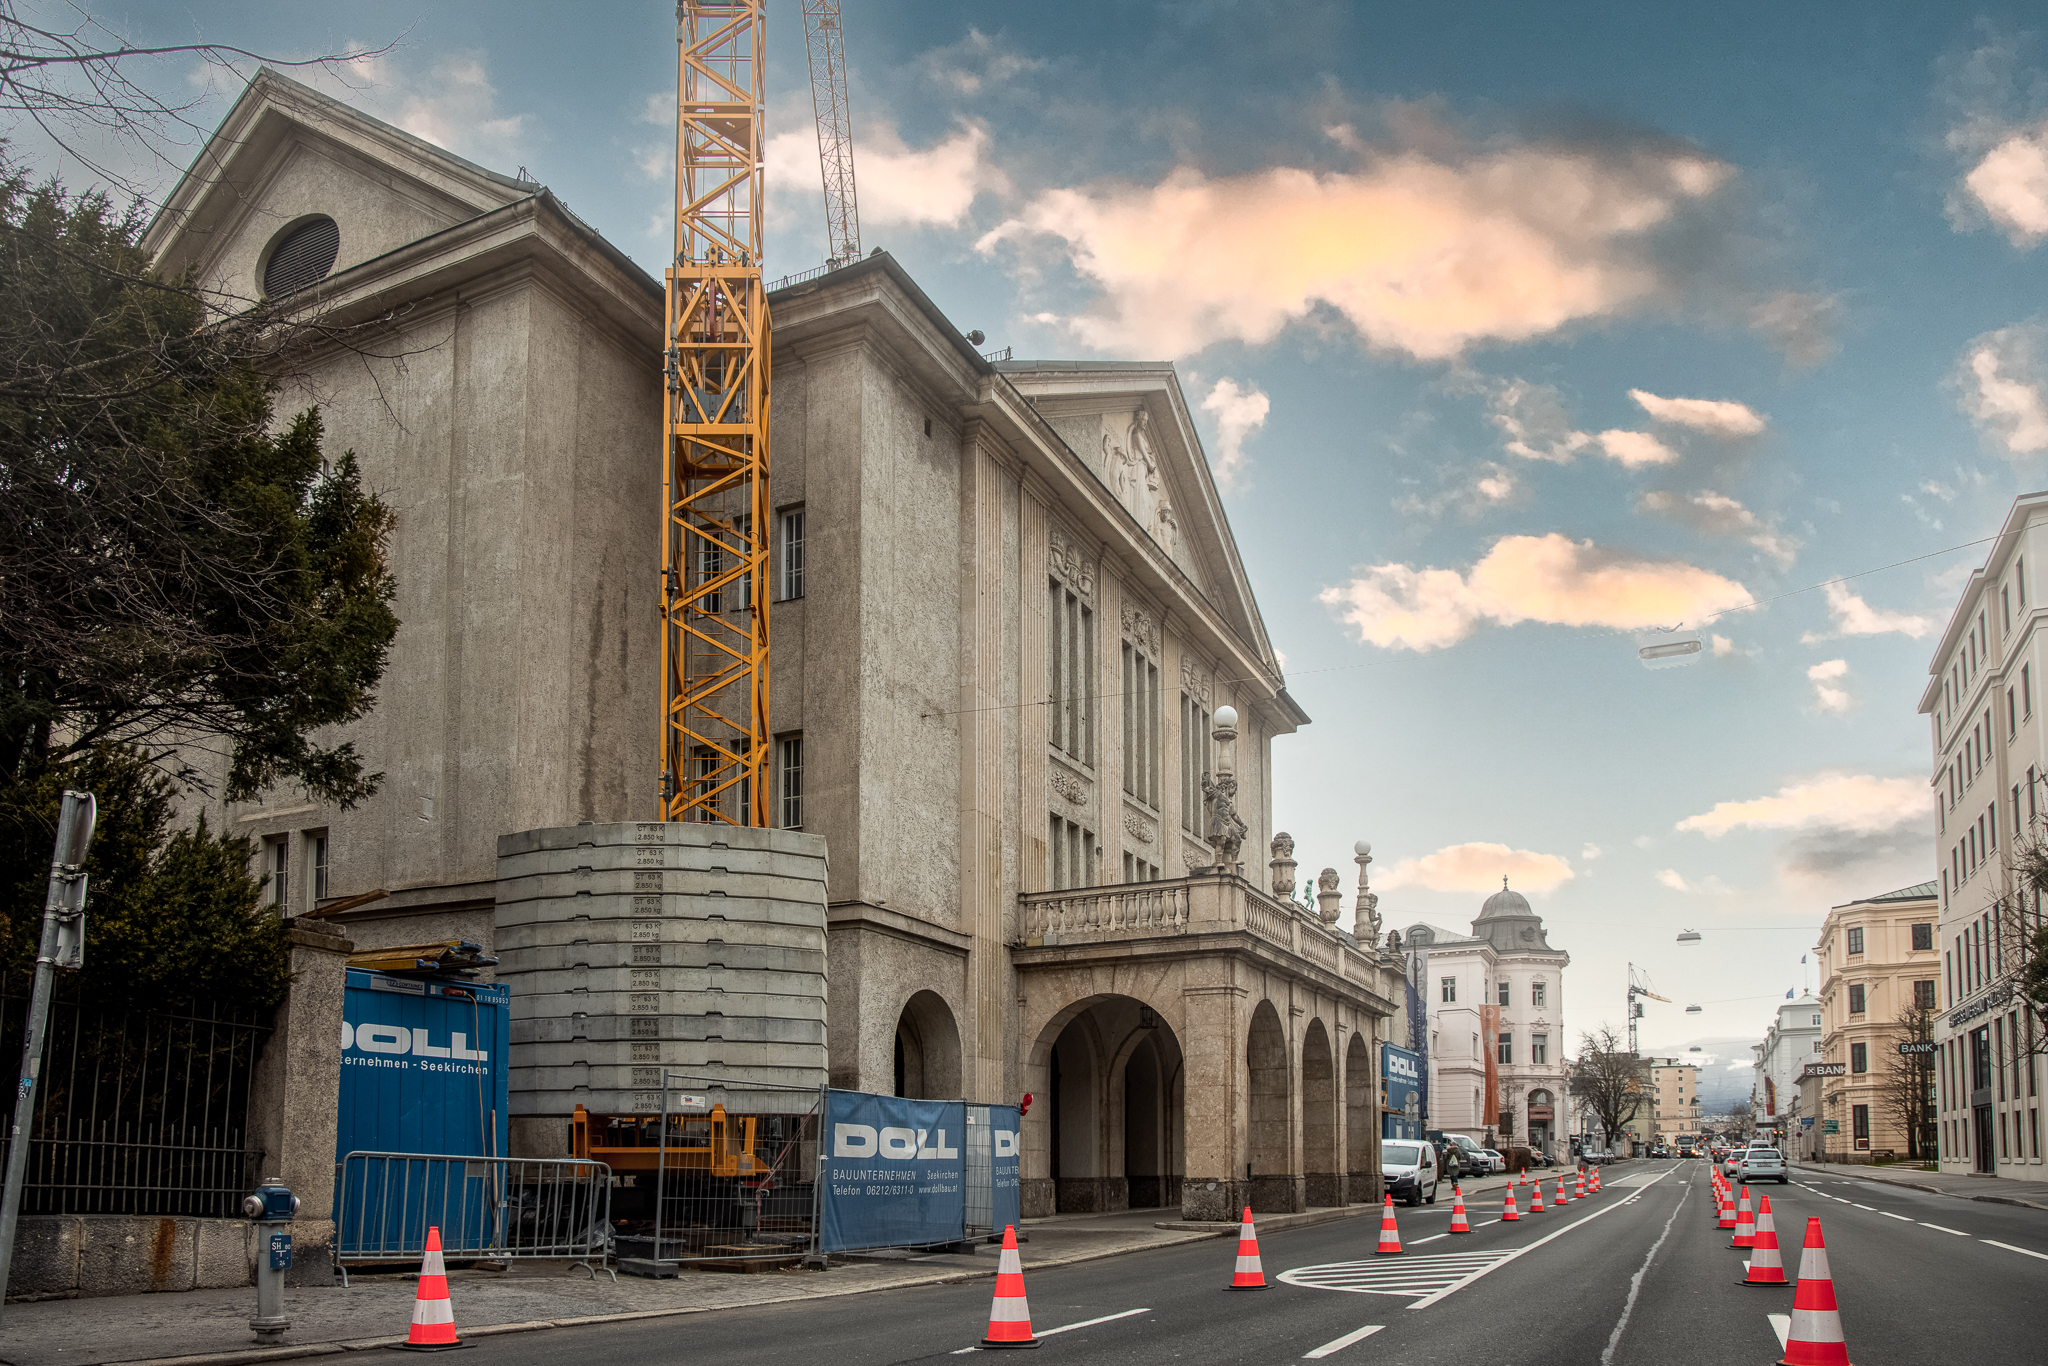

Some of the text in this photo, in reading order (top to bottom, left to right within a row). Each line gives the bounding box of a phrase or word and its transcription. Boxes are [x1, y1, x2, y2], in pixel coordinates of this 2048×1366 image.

[342, 1021, 487, 1061] OLL
[1901, 1044, 1933, 1052] BANK
[420, 1060, 488, 1074] Seekirchen
[1389, 1054, 1418, 1078] DOLL
[1817, 1066, 1846, 1074] BANK
[834, 1123, 958, 1160] DOLL
[833, 1169, 958, 1180] BAUUNTERNEHMEN Seekirchen
[833, 1184, 958, 1195] Telefon 06212/6311-0 www.dollbau.at
[272, 1242, 281, 1250] SH
